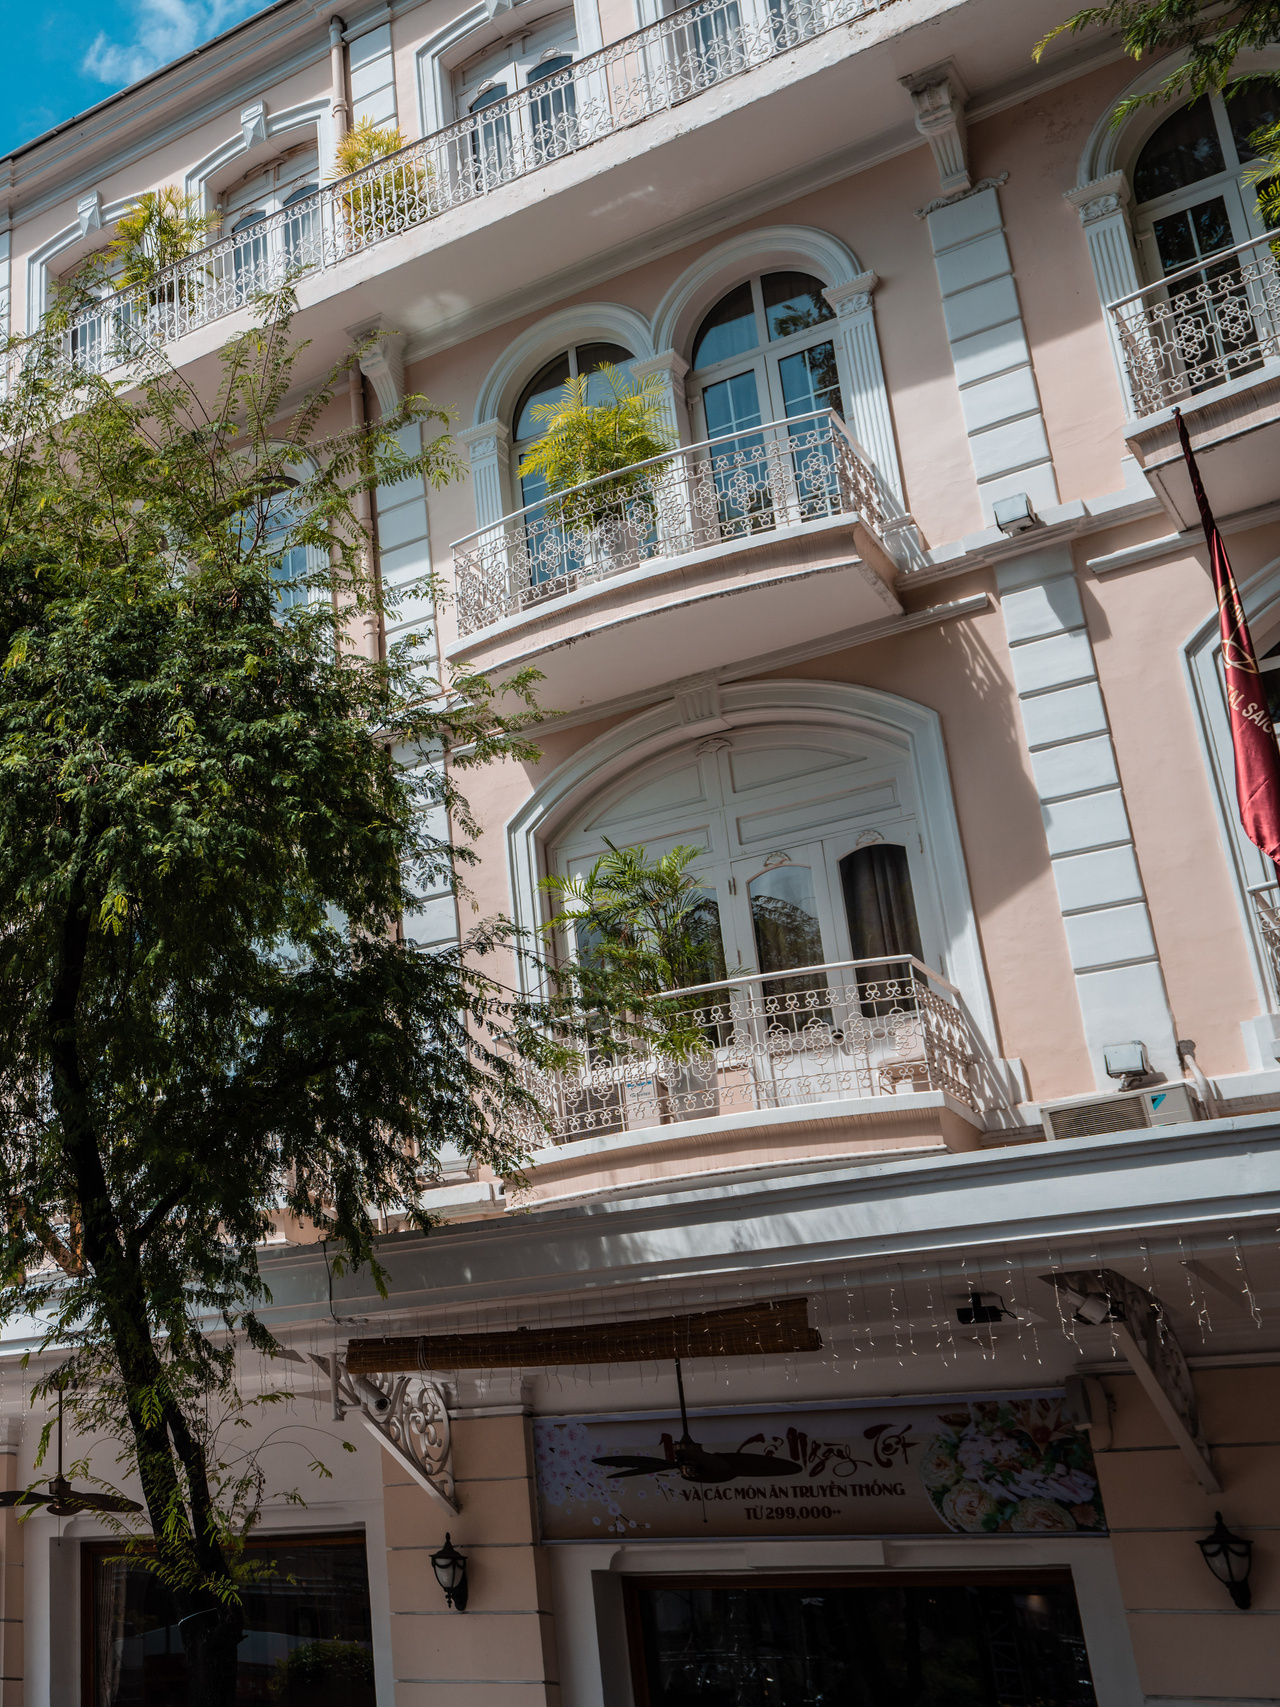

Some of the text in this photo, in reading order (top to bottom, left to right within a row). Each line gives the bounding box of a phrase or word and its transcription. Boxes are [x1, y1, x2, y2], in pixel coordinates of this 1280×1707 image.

[1241, 702, 1274, 740] SAIG
[683, 1487, 702, 1502] VÀ
[704, 1485, 732, 1500] CÁC
[734, 1484, 766, 1500] MÓN
[770, 1483, 789, 1499] ĂN
[850, 1478, 906, 1497] THỐNG
[744, 1505, 764, 1520] TỪ
